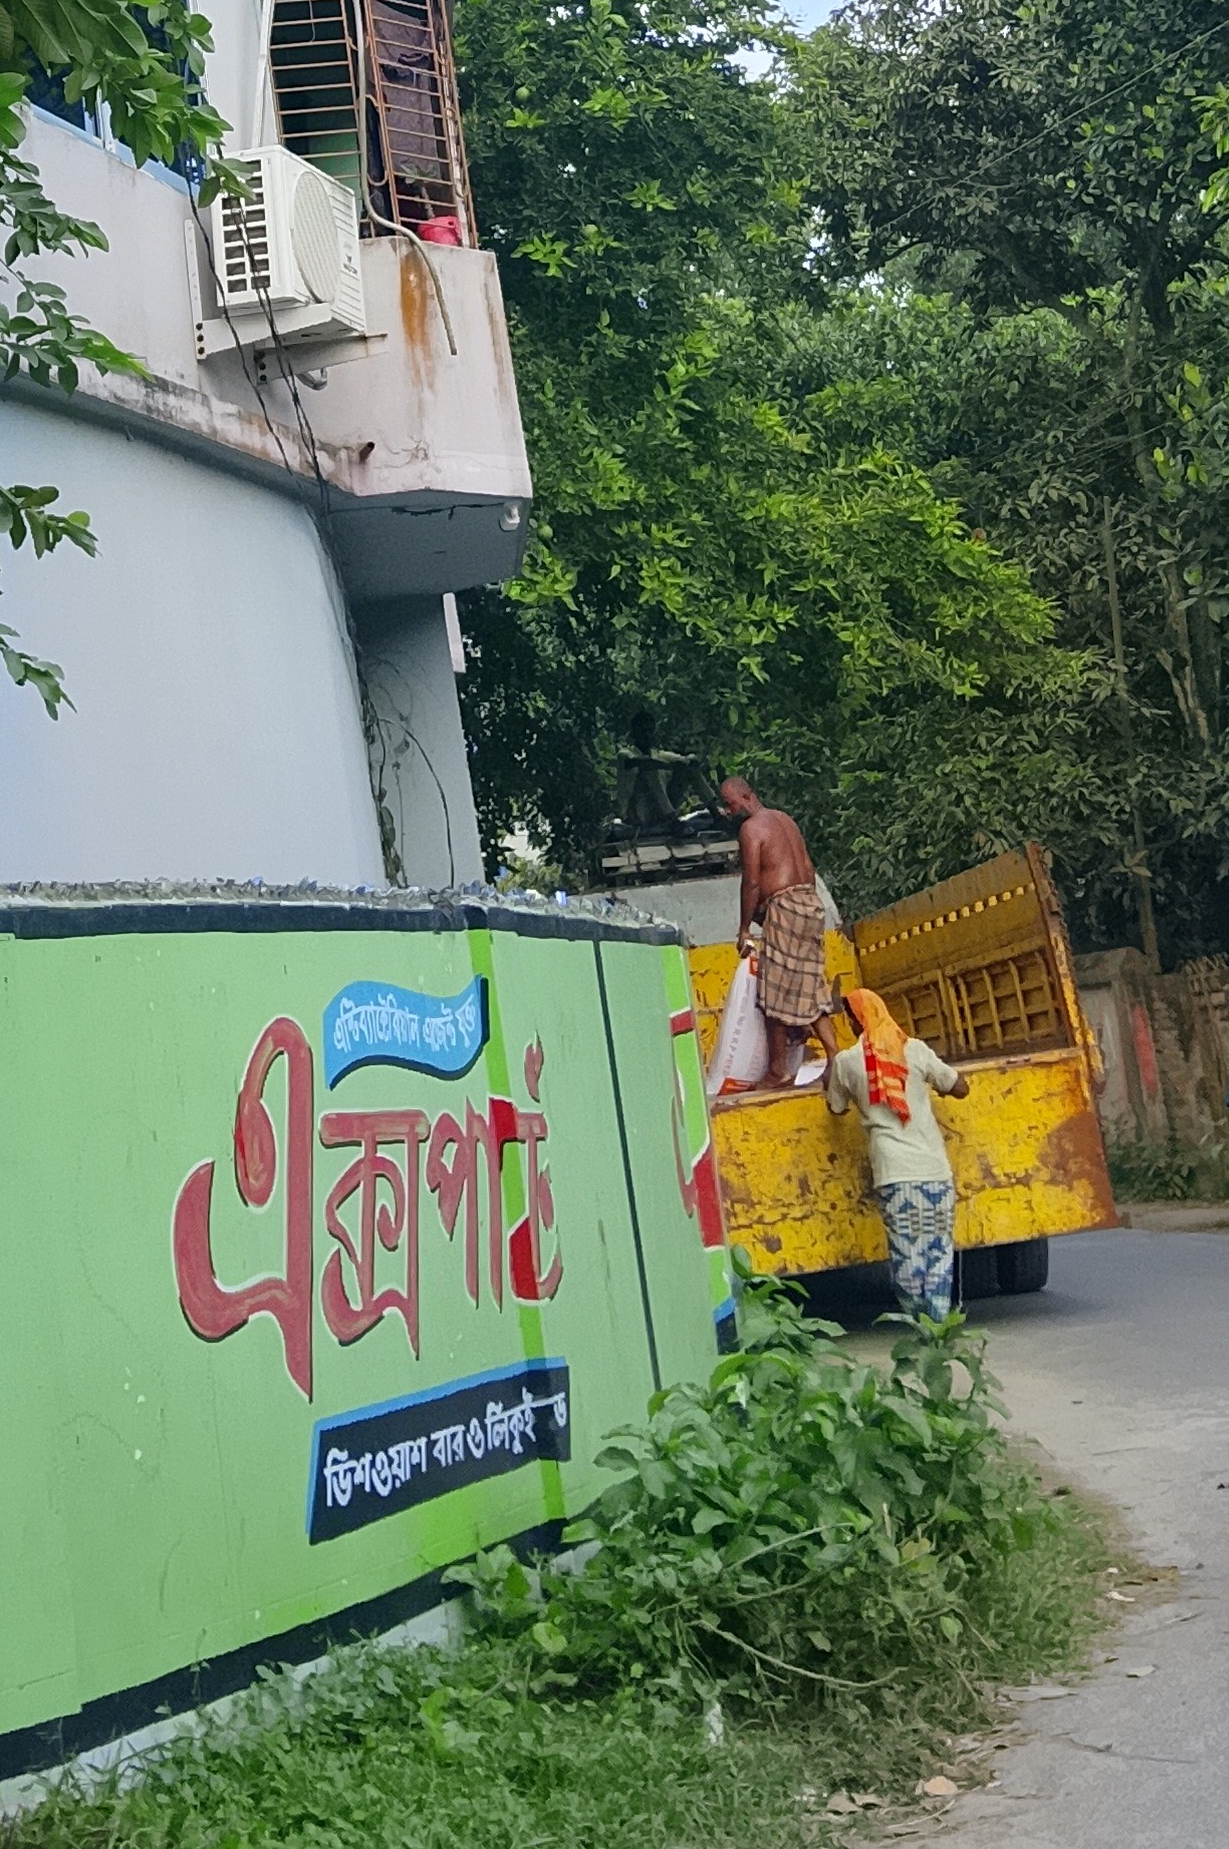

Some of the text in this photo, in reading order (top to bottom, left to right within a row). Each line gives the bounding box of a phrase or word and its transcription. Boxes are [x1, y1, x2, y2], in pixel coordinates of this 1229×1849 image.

[324, 1447, 428, 1507] ডিশওয়াশ
[430, 1424, 465, 1468] বার
[466, 1417, 485, 1460] ও
